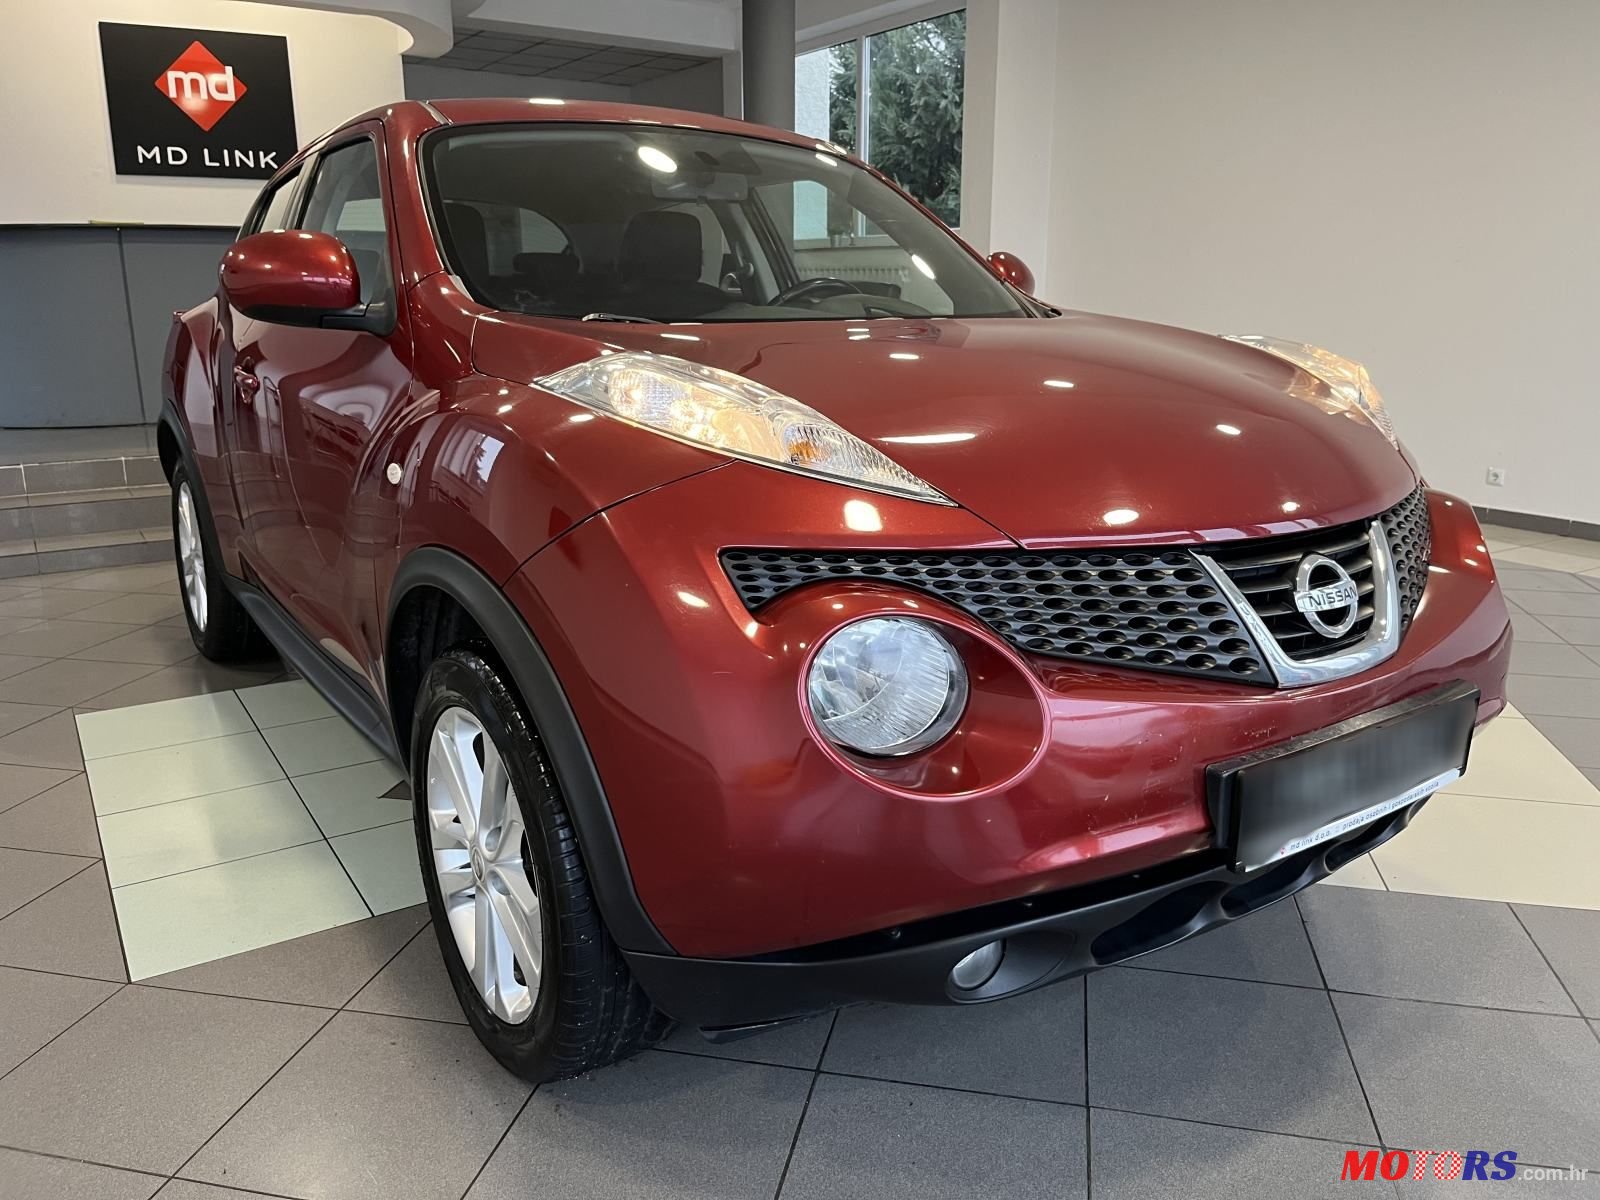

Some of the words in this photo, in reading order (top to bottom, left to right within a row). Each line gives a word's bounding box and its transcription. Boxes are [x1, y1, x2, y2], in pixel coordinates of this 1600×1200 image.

[167, 65, 236, 102] md
[137, 145, 188, 165] MD
[203, 148, 279, 169] LINK
[1308, 586, 1357, 608] NISSAN
